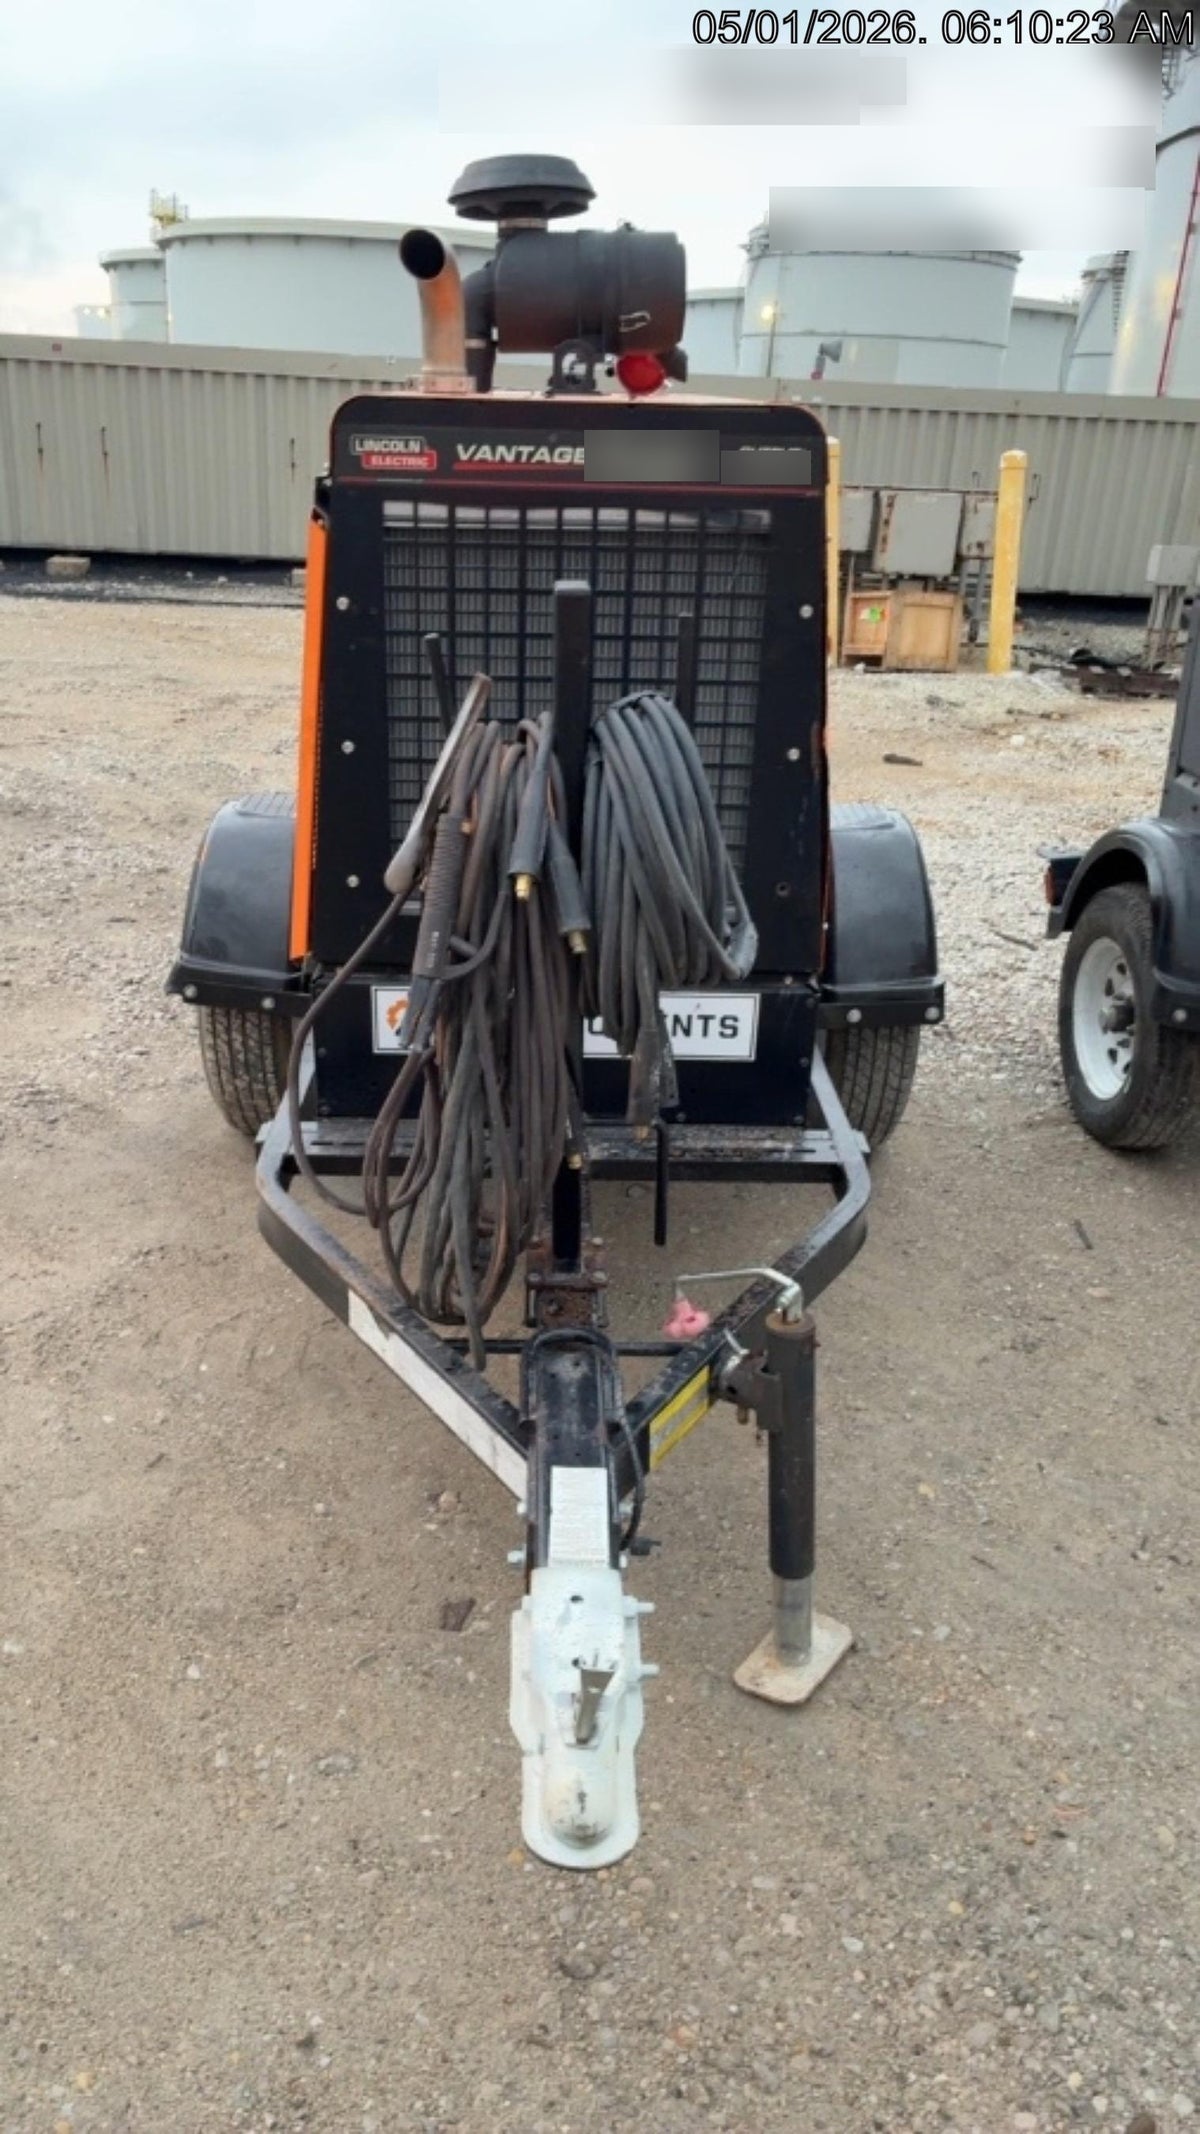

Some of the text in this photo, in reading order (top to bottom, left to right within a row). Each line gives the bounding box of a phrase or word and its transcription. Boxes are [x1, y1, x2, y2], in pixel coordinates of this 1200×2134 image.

[355, 437, 421, 454] LINCOLN
[456, 443, 585, 465] VANTAGE
[370, 454, 430, 468] ELECTRIC
